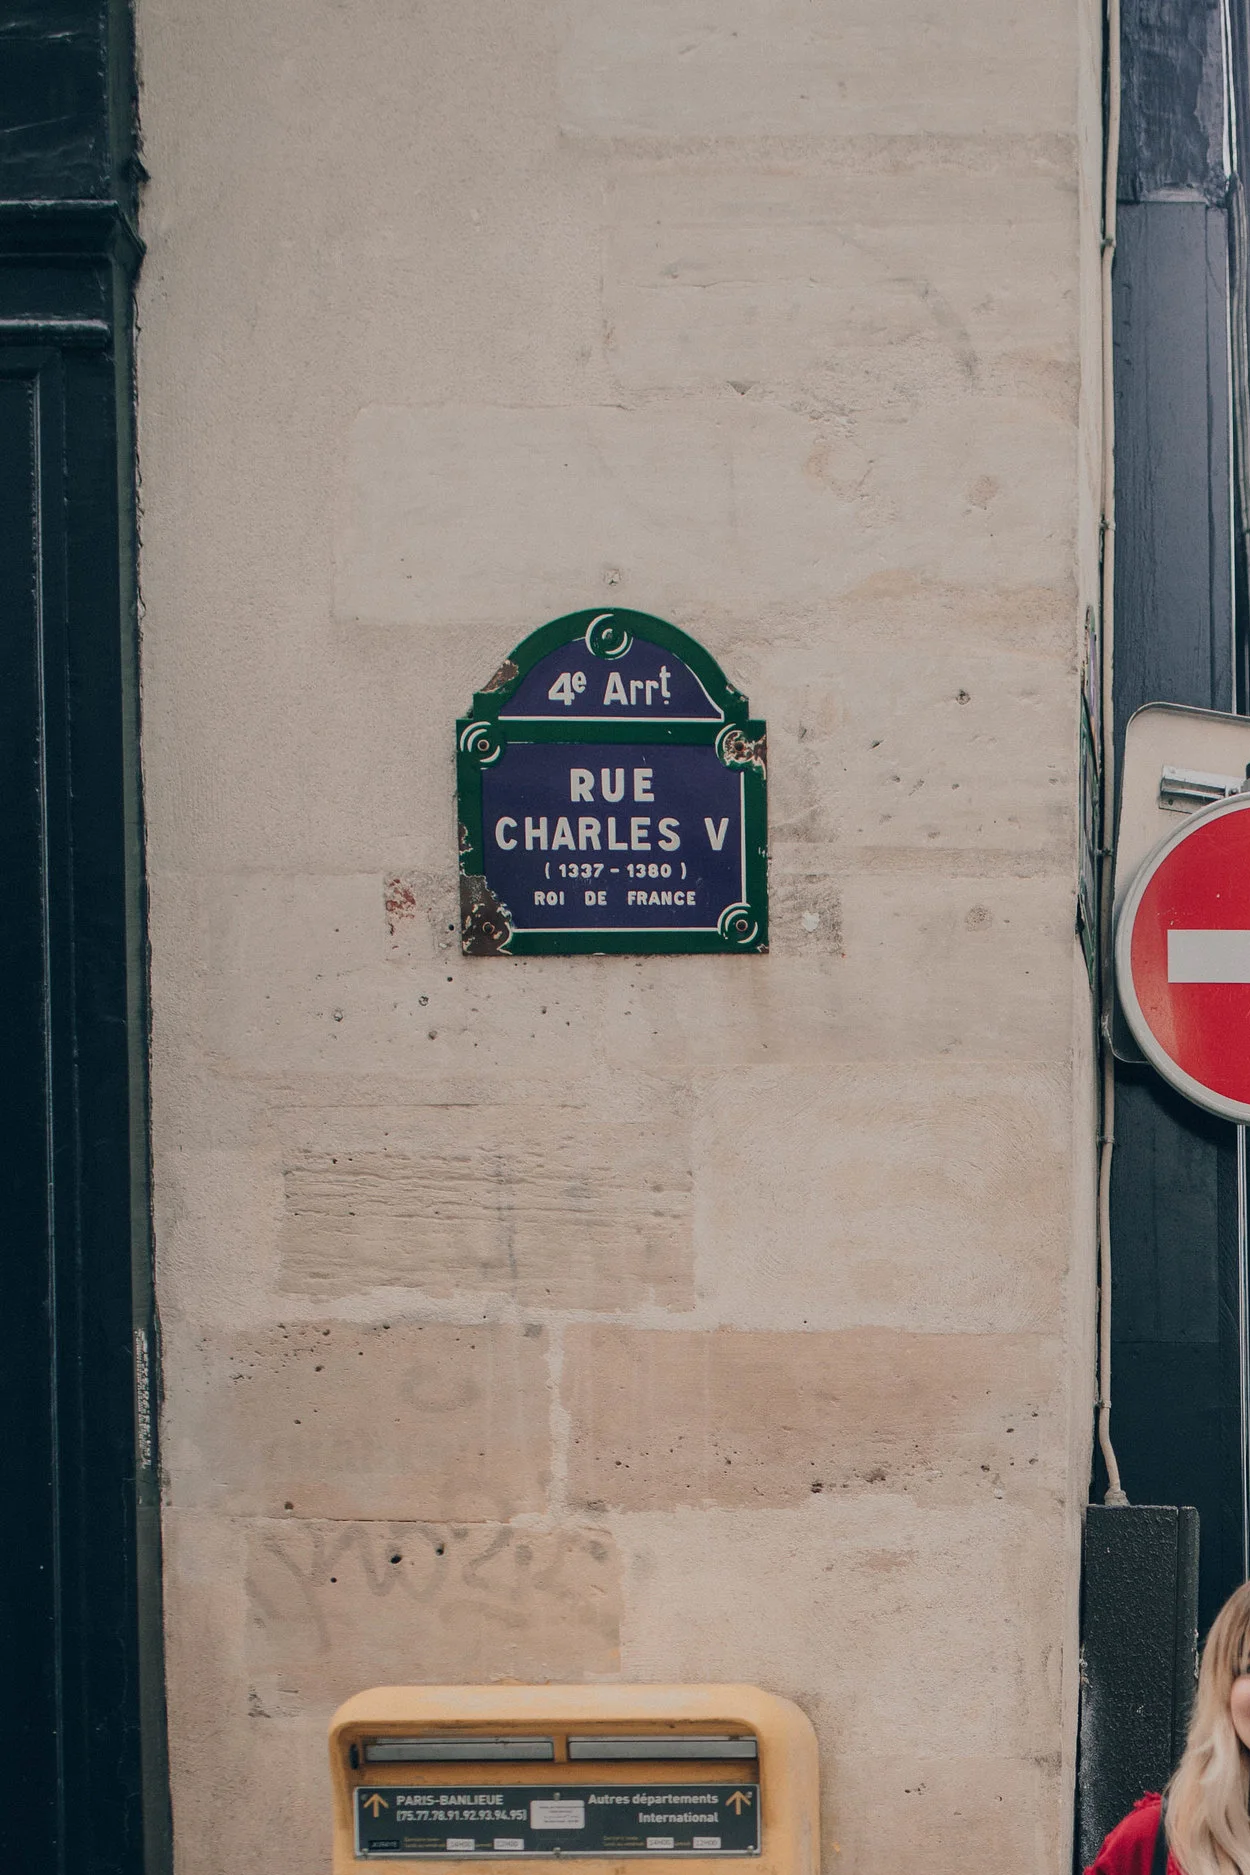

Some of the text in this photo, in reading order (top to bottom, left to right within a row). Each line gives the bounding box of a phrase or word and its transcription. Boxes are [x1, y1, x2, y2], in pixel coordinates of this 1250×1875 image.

[548, 671, 587, 706] 4e
[569, 767, 655, 803] RUE
[494, 816, 730, 852] CHARLES V
[533, 890, 697, 906] ROI DE FRANCE
[396, 1794, 505, 1806] PARIS-BANLIEUE
[588, 1792, 719, 1807] Autres départements
[638, 1811, 719, 1823] International
